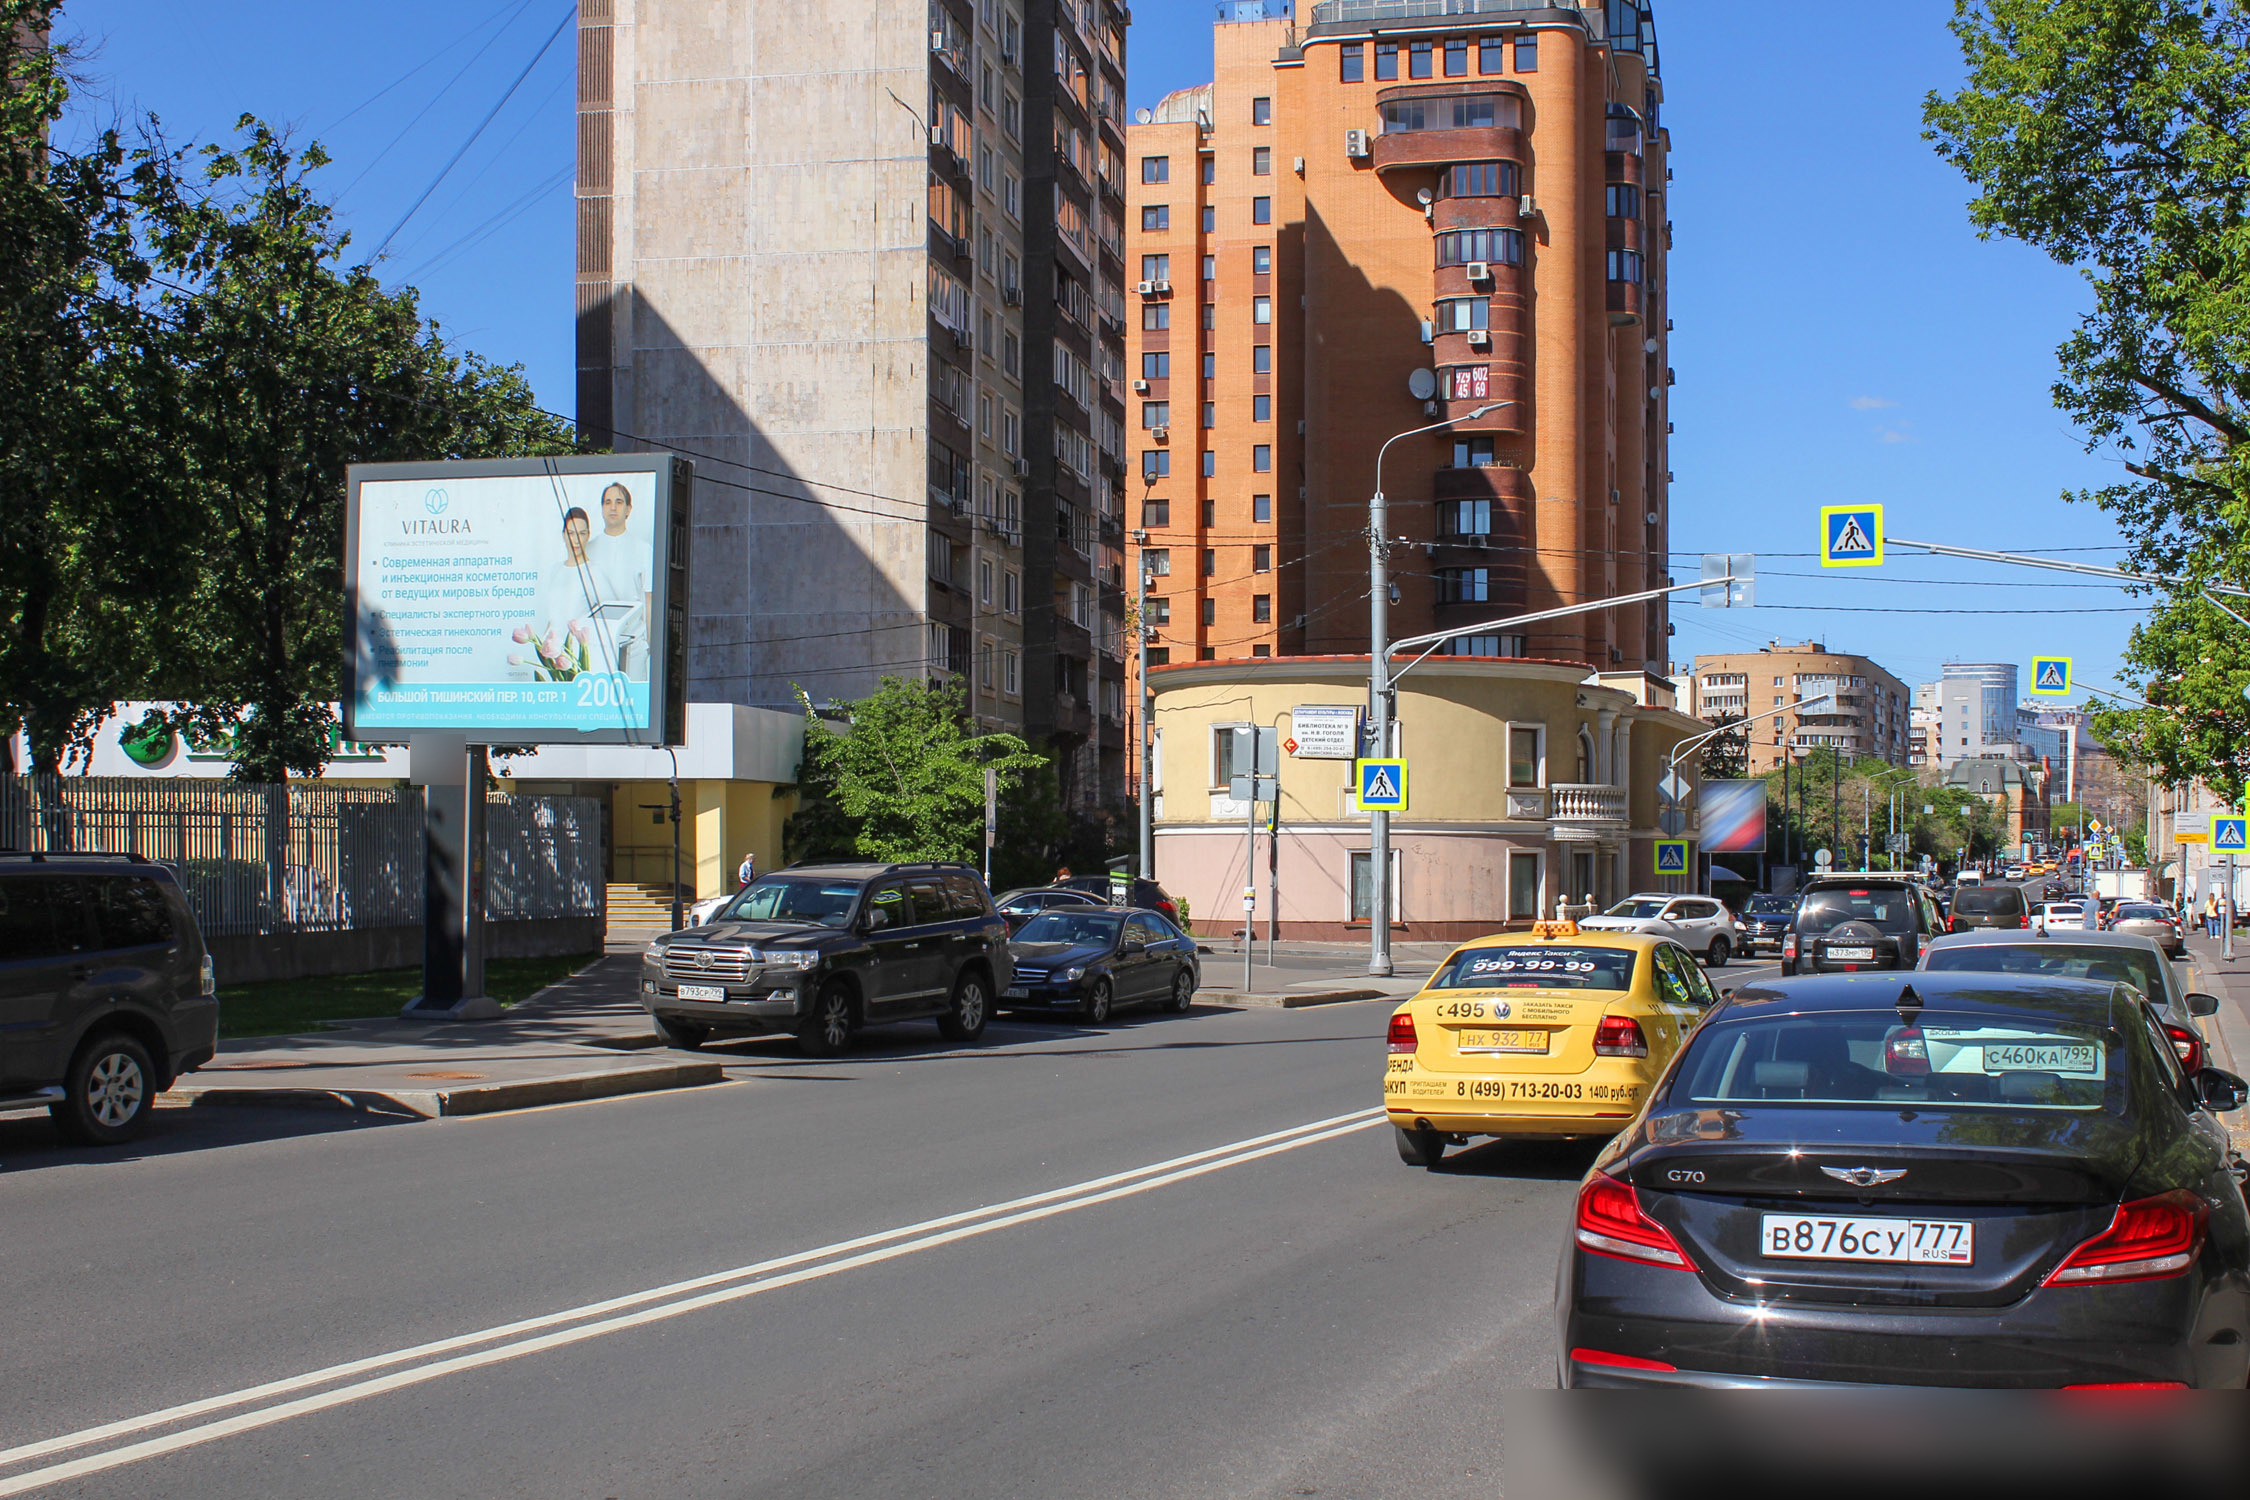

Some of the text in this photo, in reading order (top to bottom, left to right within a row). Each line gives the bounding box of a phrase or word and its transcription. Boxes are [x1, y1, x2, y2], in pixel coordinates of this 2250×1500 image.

[1456, 366, 1488, 384] 929 602
[1458, 382, 1486, 398] 45 69
[402, 519, 472, 534] VITAURA
[382, 556, 512, 570] Современная аппаратная
[382, 572, 538, 584] и инъекционная косметология
[382, 586, 535, 600] от ведущих мировых брендов
[380, 609, 535, 620] Специалисты экспертного уровня
[380, 628, 502, 637] Эстетическая гинекология
[446, 646, 472, 655] после
[378, 688, 566, 704] БОЛЬШОЙ ТИШИНСКИЙ ПЕР. 10, СТР. 1
[577, 678, 624, 707] 200
[1472, 960, 1595, 972] 999-99-99
[680, 986, 709, 996] В793СР
[1448, 1003, 1484, 1017] 495
[1467, 1032, 1542, 1046] НХ 932 77
[1989, 1047, 2089, 1064] С460КА 799
[1387, 1060, 1413, 1074] РЕНДА
[1384, 1081, 1406, 1094] ЫКУП
[1457, 1082, 1465, 1096] 8
[1470, 1081, 1505, 1101] (499)
[1510, 1083, 1582, 1098] 713-20-03
[1589, 1086, 1608, 1099] 1400
[1667, 1170, 1705, 1183] G70
[1773, 1220, 1964, 1256] В876СУ 777
[1923, 1249, 1948, 1259] RUS
